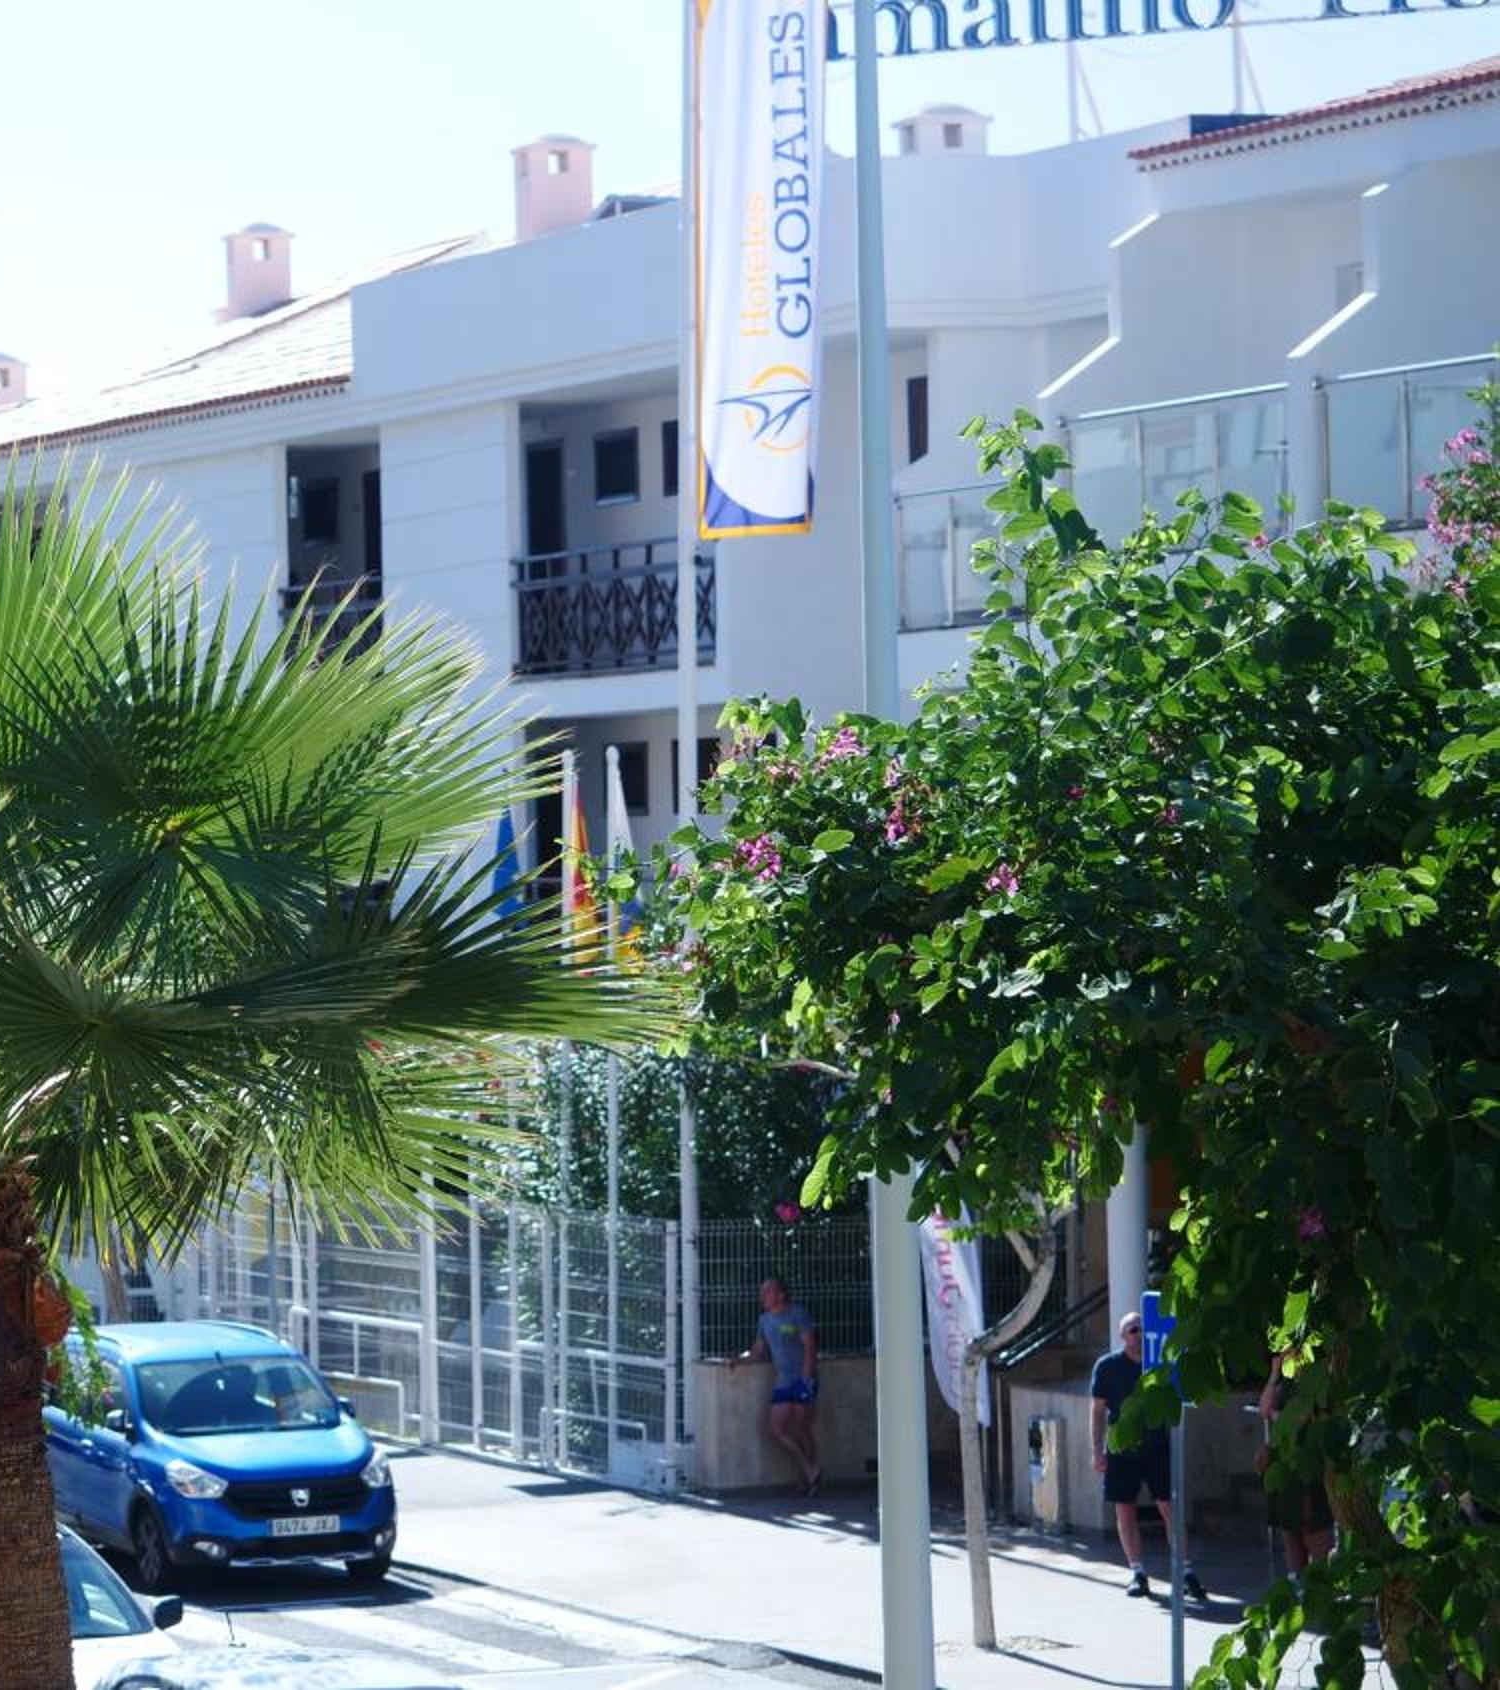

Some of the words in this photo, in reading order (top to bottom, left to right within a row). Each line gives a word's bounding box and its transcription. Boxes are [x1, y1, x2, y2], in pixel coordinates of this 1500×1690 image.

[769, 10, 812, 339] GLOBALES
[740, 191, 771, 337] Hoteles
[276, 1519, 308, 1535] 9474
